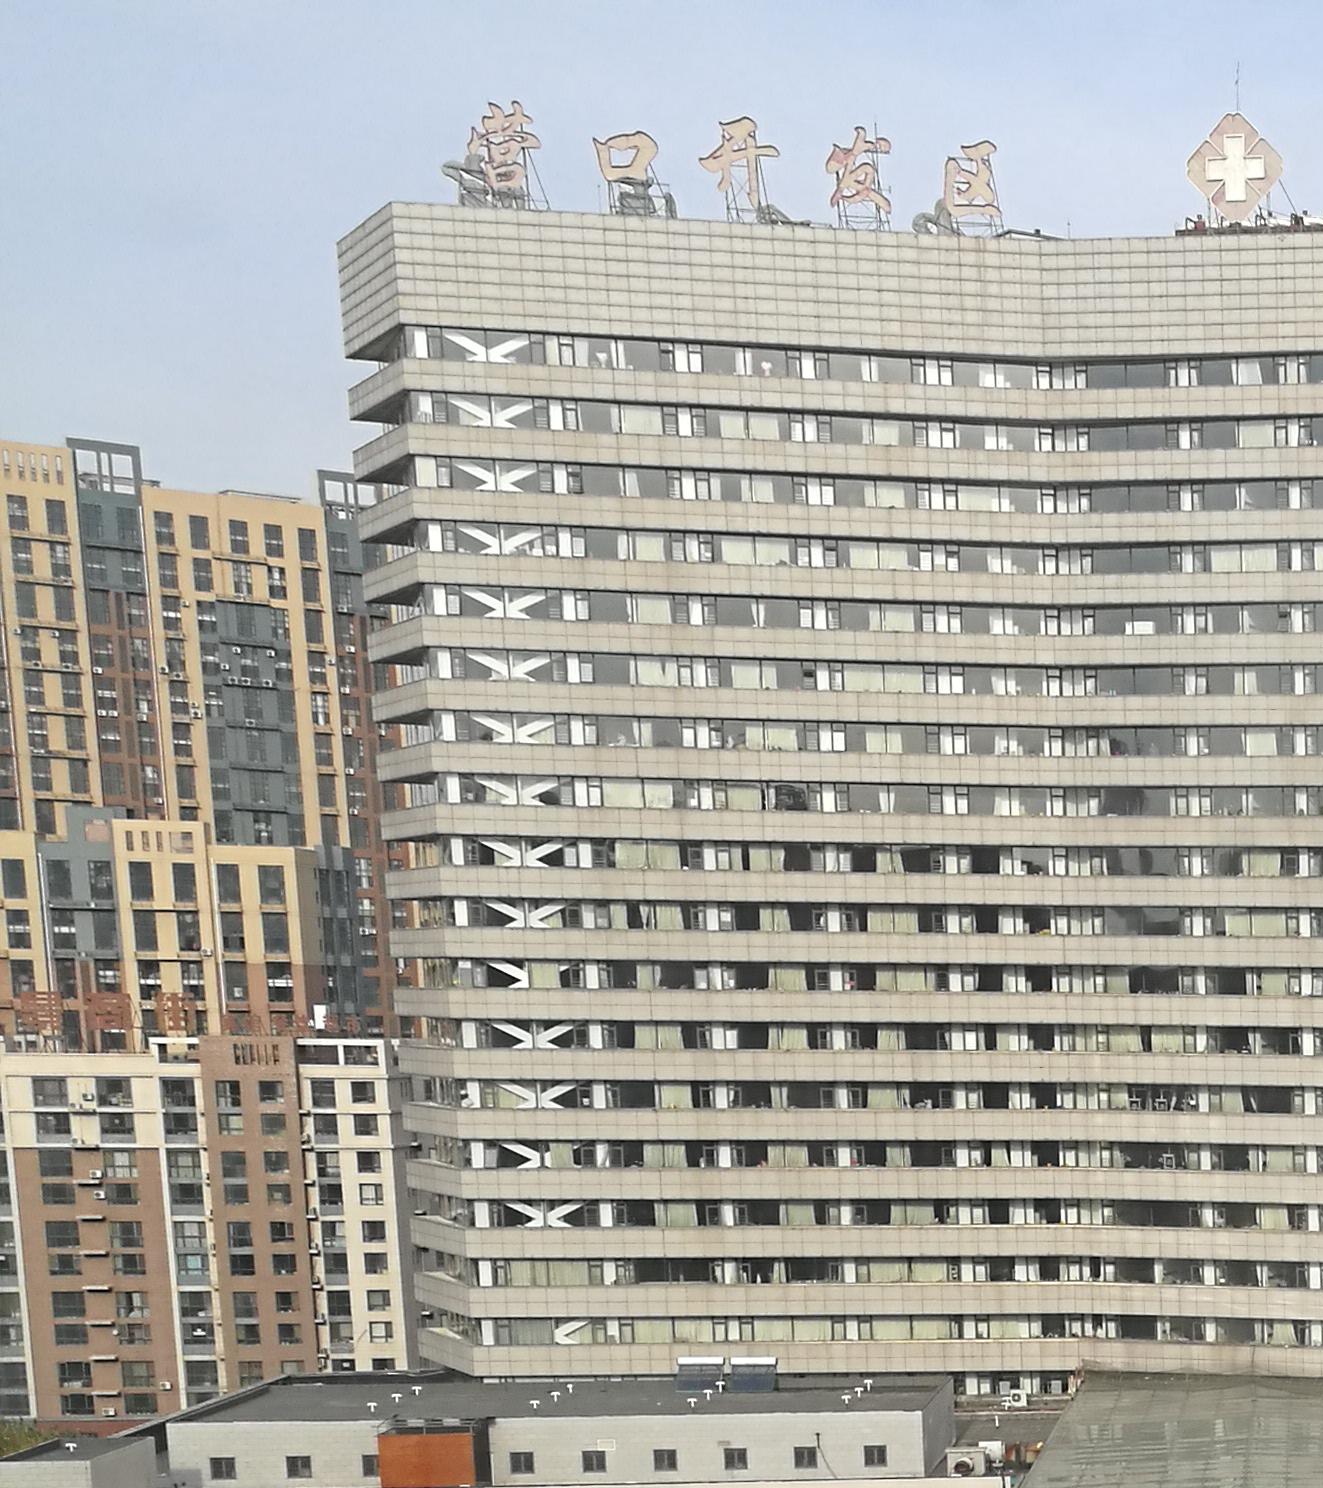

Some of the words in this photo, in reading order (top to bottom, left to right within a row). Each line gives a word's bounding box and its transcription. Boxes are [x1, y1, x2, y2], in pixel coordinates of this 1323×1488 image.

[467, 100, 1002, 218] 营口开发区
